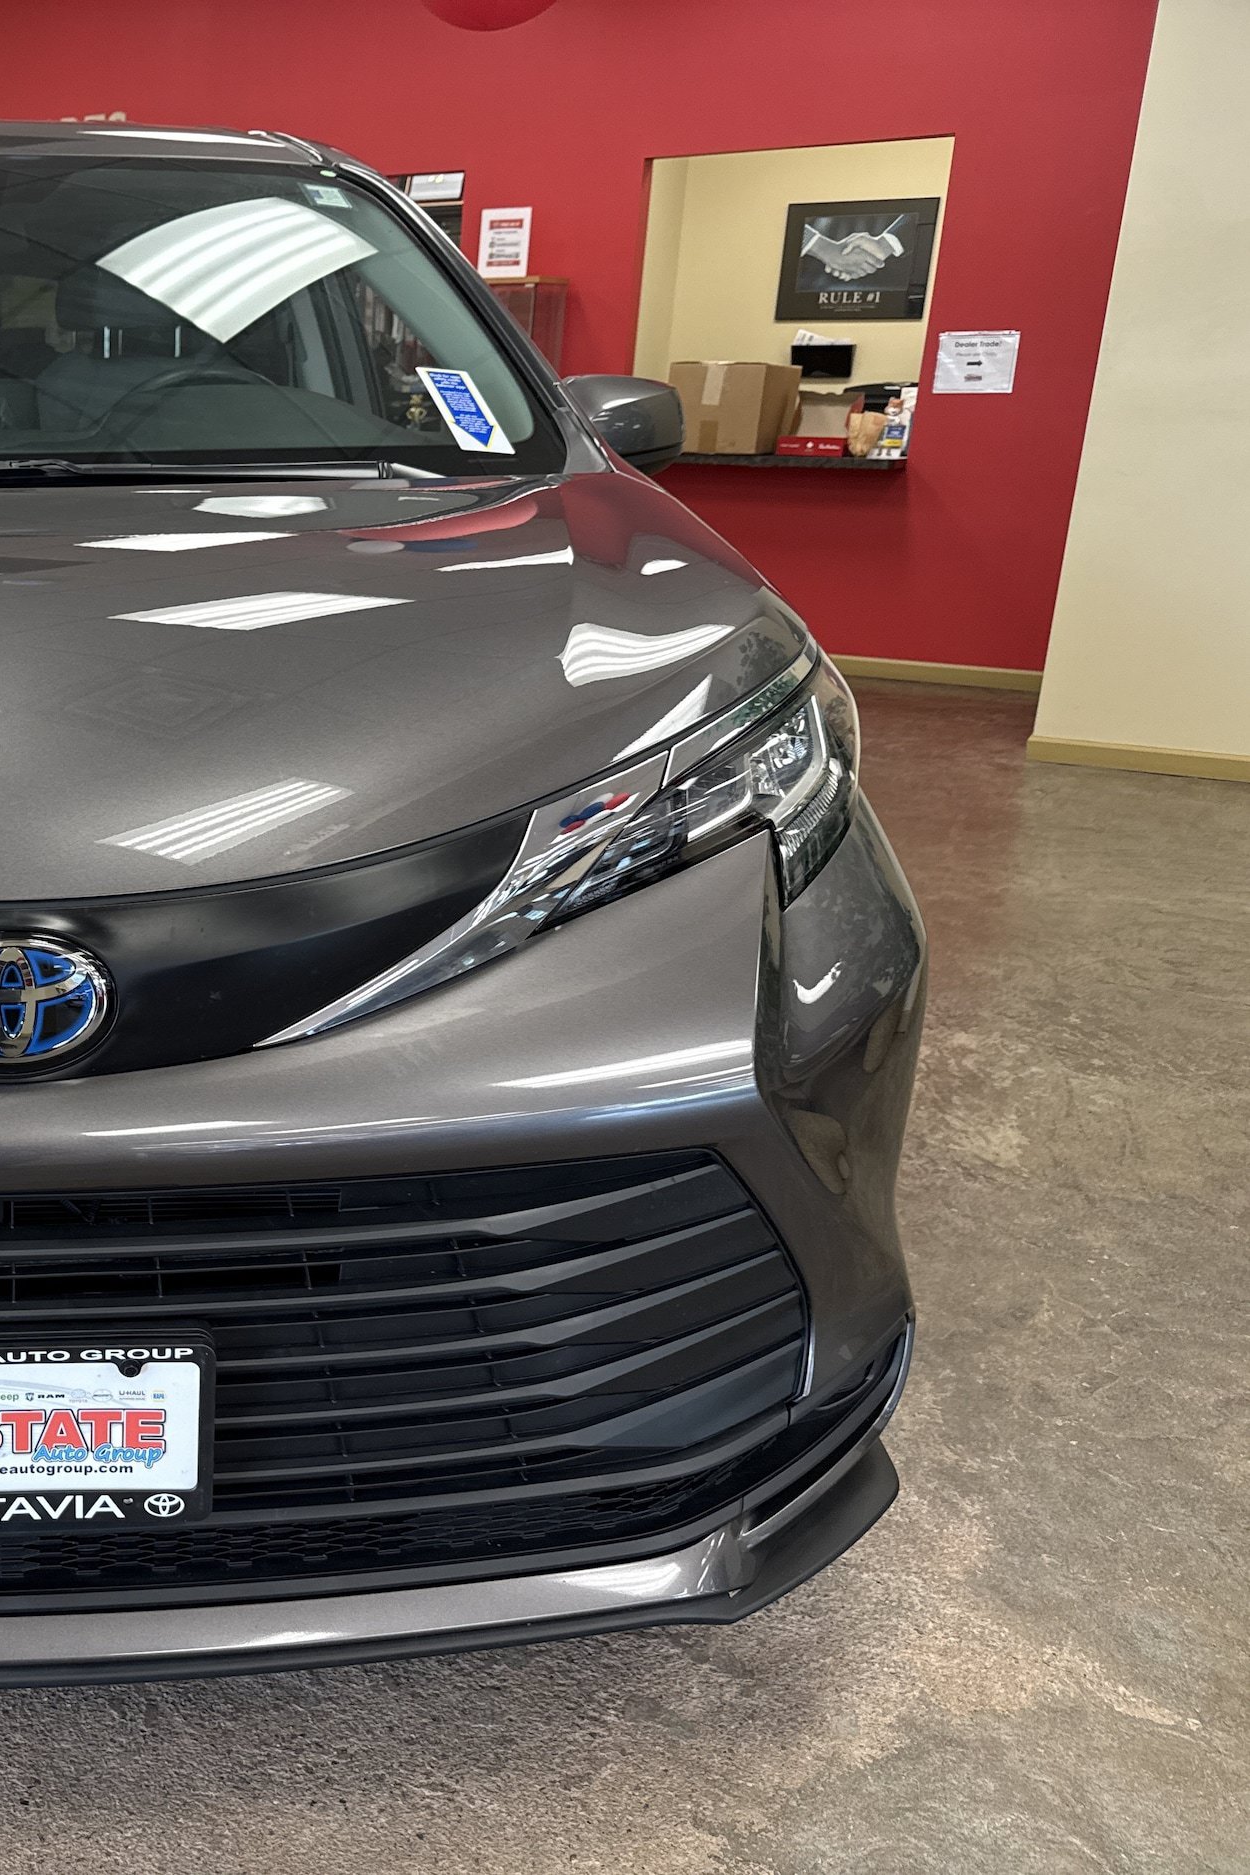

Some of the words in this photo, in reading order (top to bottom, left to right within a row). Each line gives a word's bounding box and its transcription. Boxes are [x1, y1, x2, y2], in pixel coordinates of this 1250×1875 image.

[818, 291, 863, 304] RULE
[866, 291, 881, 304] #1
[80, 1348, 194, 1361] GROUP
[32, 1443, 87, 1463] Auto
[93, 1443, 164, 1469] Group
